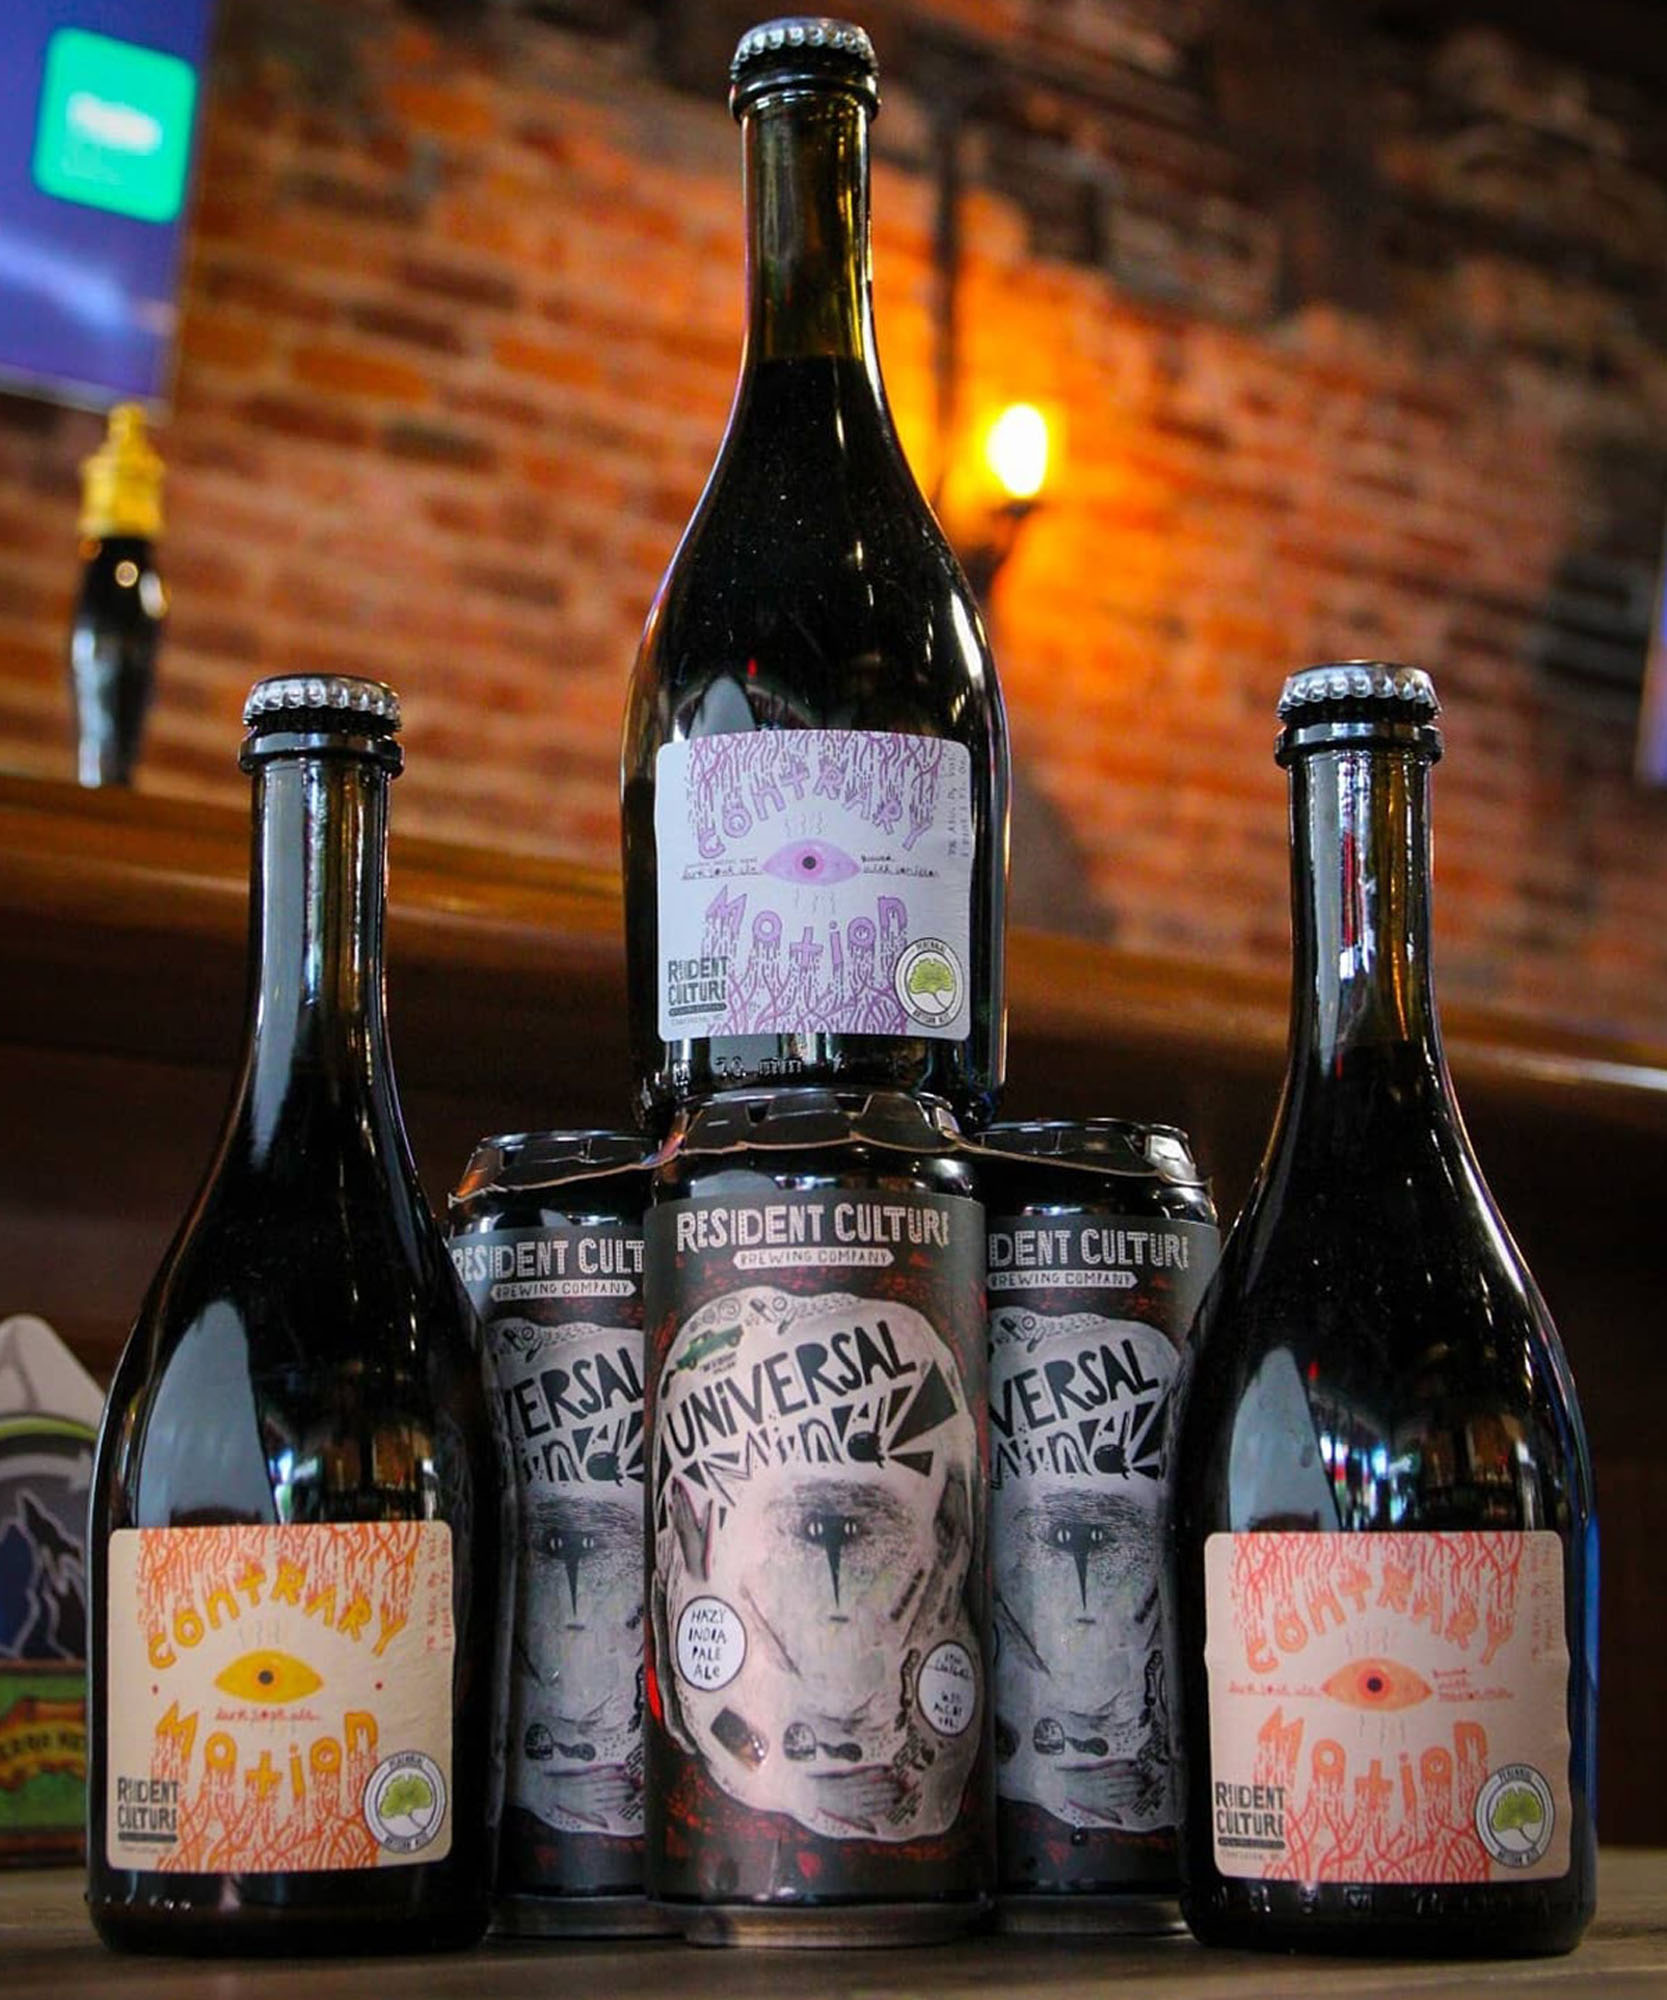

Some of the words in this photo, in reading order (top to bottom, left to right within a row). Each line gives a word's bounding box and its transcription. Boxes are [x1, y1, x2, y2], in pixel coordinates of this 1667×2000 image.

[677, 1204, 824, 1252] RESIDENT
[739, 1250, 813, 1267] BREWING
[817, 1250, 889, 1265] COMPANY
[990, 1271, 1060, 1288] BREWING
[1065, 1271, 1131, 1286] COMPANY
[496, 1282, 556, 1298] BREWING
[562, 1279, 630, 1295] COMPANY
[690, 1608, 727, 1624] HAZY
[688, 1627, 727, 1645] INDIA
[692, 1645, 721, 1661] PALE
